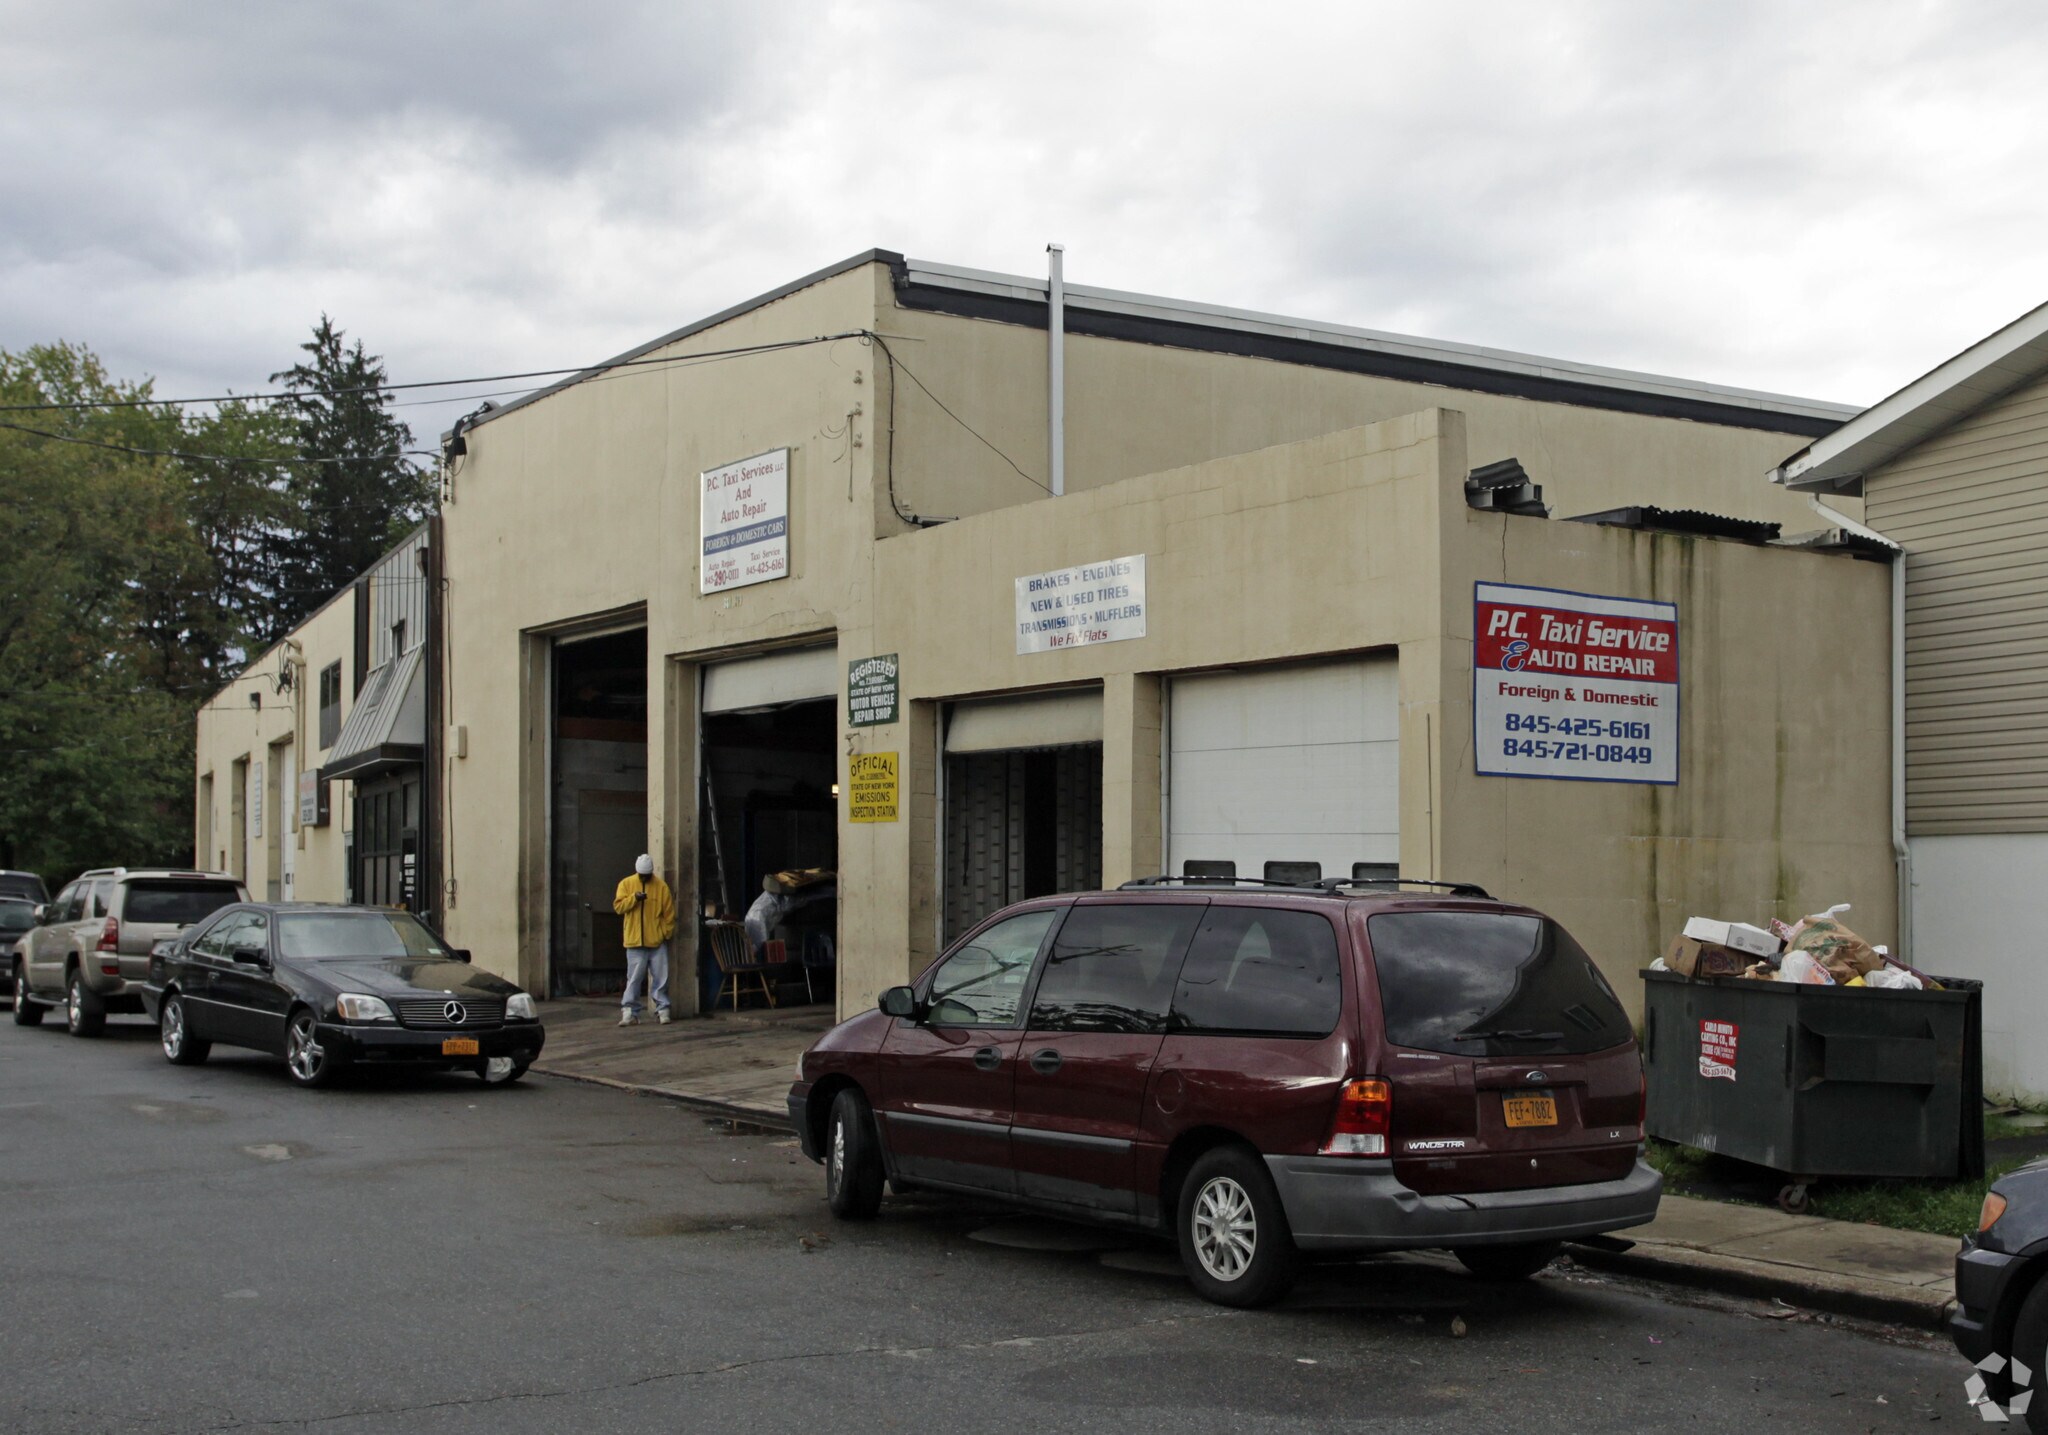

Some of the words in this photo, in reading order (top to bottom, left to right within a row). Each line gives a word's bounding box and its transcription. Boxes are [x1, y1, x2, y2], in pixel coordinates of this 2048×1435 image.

[722, 471, 739, 487] Taxi
[741, 463, 773, 482] Services
[736, 484, 752, 501] And
[721, 510, 739, 523] Auto
[742, 499, 767, 518] Repair
[705, 536, 730, 551] FOREIGN
[736, 526, 767, 543] DOMESTIC
[767, 521, 784, 535] CARS
[762, 547, 780, 560] Service
[721, 558, 736, 571] Repair
[746, 557, 784, 575] 845-425-6161
[1029, 573, 1070, 592] BRAKES
[1082, 562, 1131, 581] ENGINES
[1030, 598, 1053, 613] NEW
[1055, 596, 1063, 608] &
[1066, 591, 1094, 607] USED
[1097, 585, 1129, 601] TIRES
[1095, 604, 1141, 623] MUFFLERS
[1050, 635, 1064, 647] We
[1083, 629, 1108, 642] Flats
[1487, 609, 1528, 639] P.C.
[1539, 613, 1584, 644] Taxi
[1586, 620, 1670, 652] Service
[1527, 649, 1577, 670] AUTO
[1584, 654, 1655, 676] REPAIR
[850, 659, 896, 685] REGISTERED
[851, 689, 864, 697] STATE
[864, 687, 871, 695] OF
[871, 685, 882, 694] NEW
[882, 683, 895, 692] YORK
[1498, 682, 1560, 703] Foreign
[1564, 688, 1576, 701] &
[1583, 688, 1659, 707] Domestic
[850, 696, 870, 710] MOTOR
[870, 693, 895, 708] VEHICLE
[854, 709, 875, 723] REPAIR
[875, 707, 892, 720] SHOP
[1505, 713, 1650, 740] 845-425-6161
[1503, 738, 1652, 764] 845-721-0849
[850, 756, 894, 776] OFFICIAL
[871, 782, 881, 790] NEW
[855, 791, 891, 803] EMISSIONS
[850, 806, 876, 818] INSPECTION
[877, 805, 896, 817] STATION
[1610, 1130, 1620, 1138] LX
[1408, 1140, 1465, 1150] WINDSTAR
